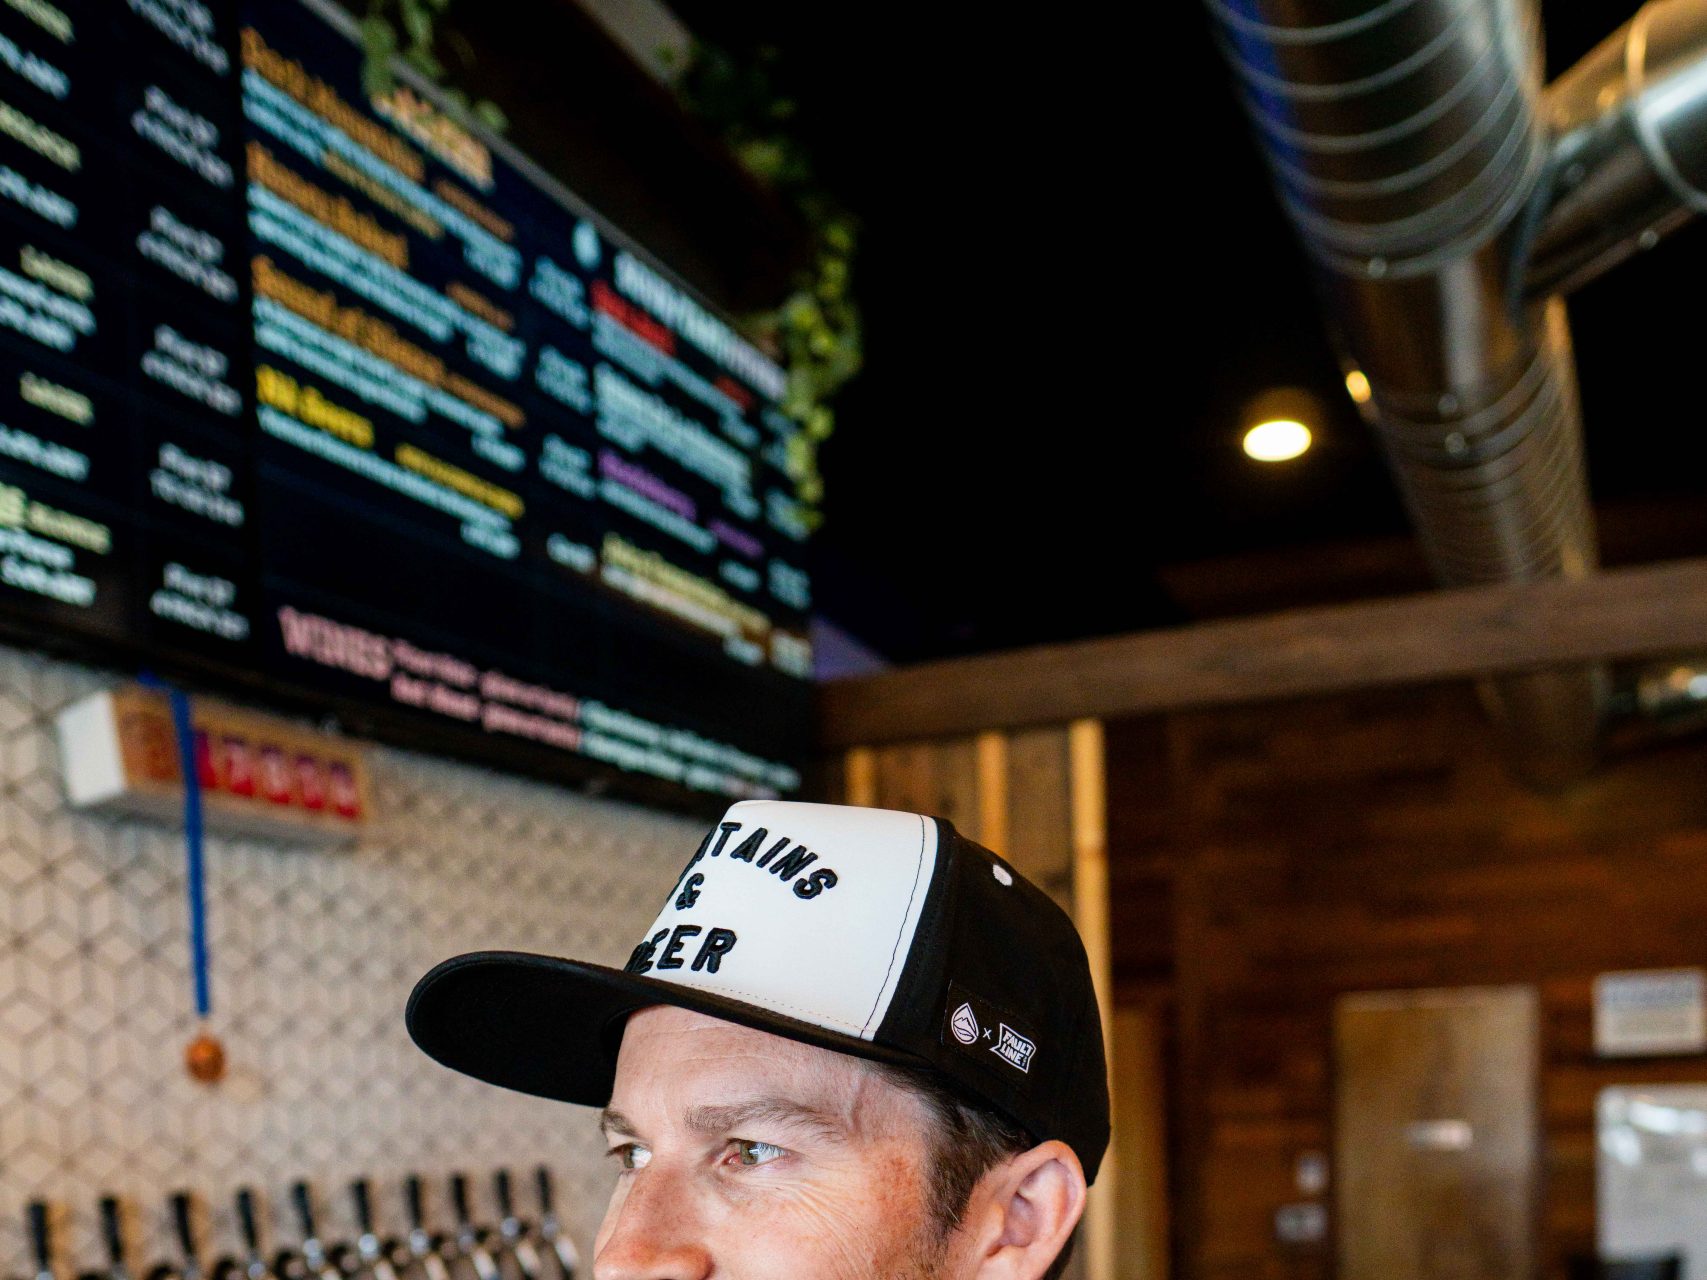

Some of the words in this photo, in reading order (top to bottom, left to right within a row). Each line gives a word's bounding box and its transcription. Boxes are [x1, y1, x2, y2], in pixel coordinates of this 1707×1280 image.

[695, 821, 839, 900] TAINS
[675, 872, 705, 911] &
[1000, 1042, 1024, 1065] LINE
[1002, 1030, 1034, 1057] FAULT
